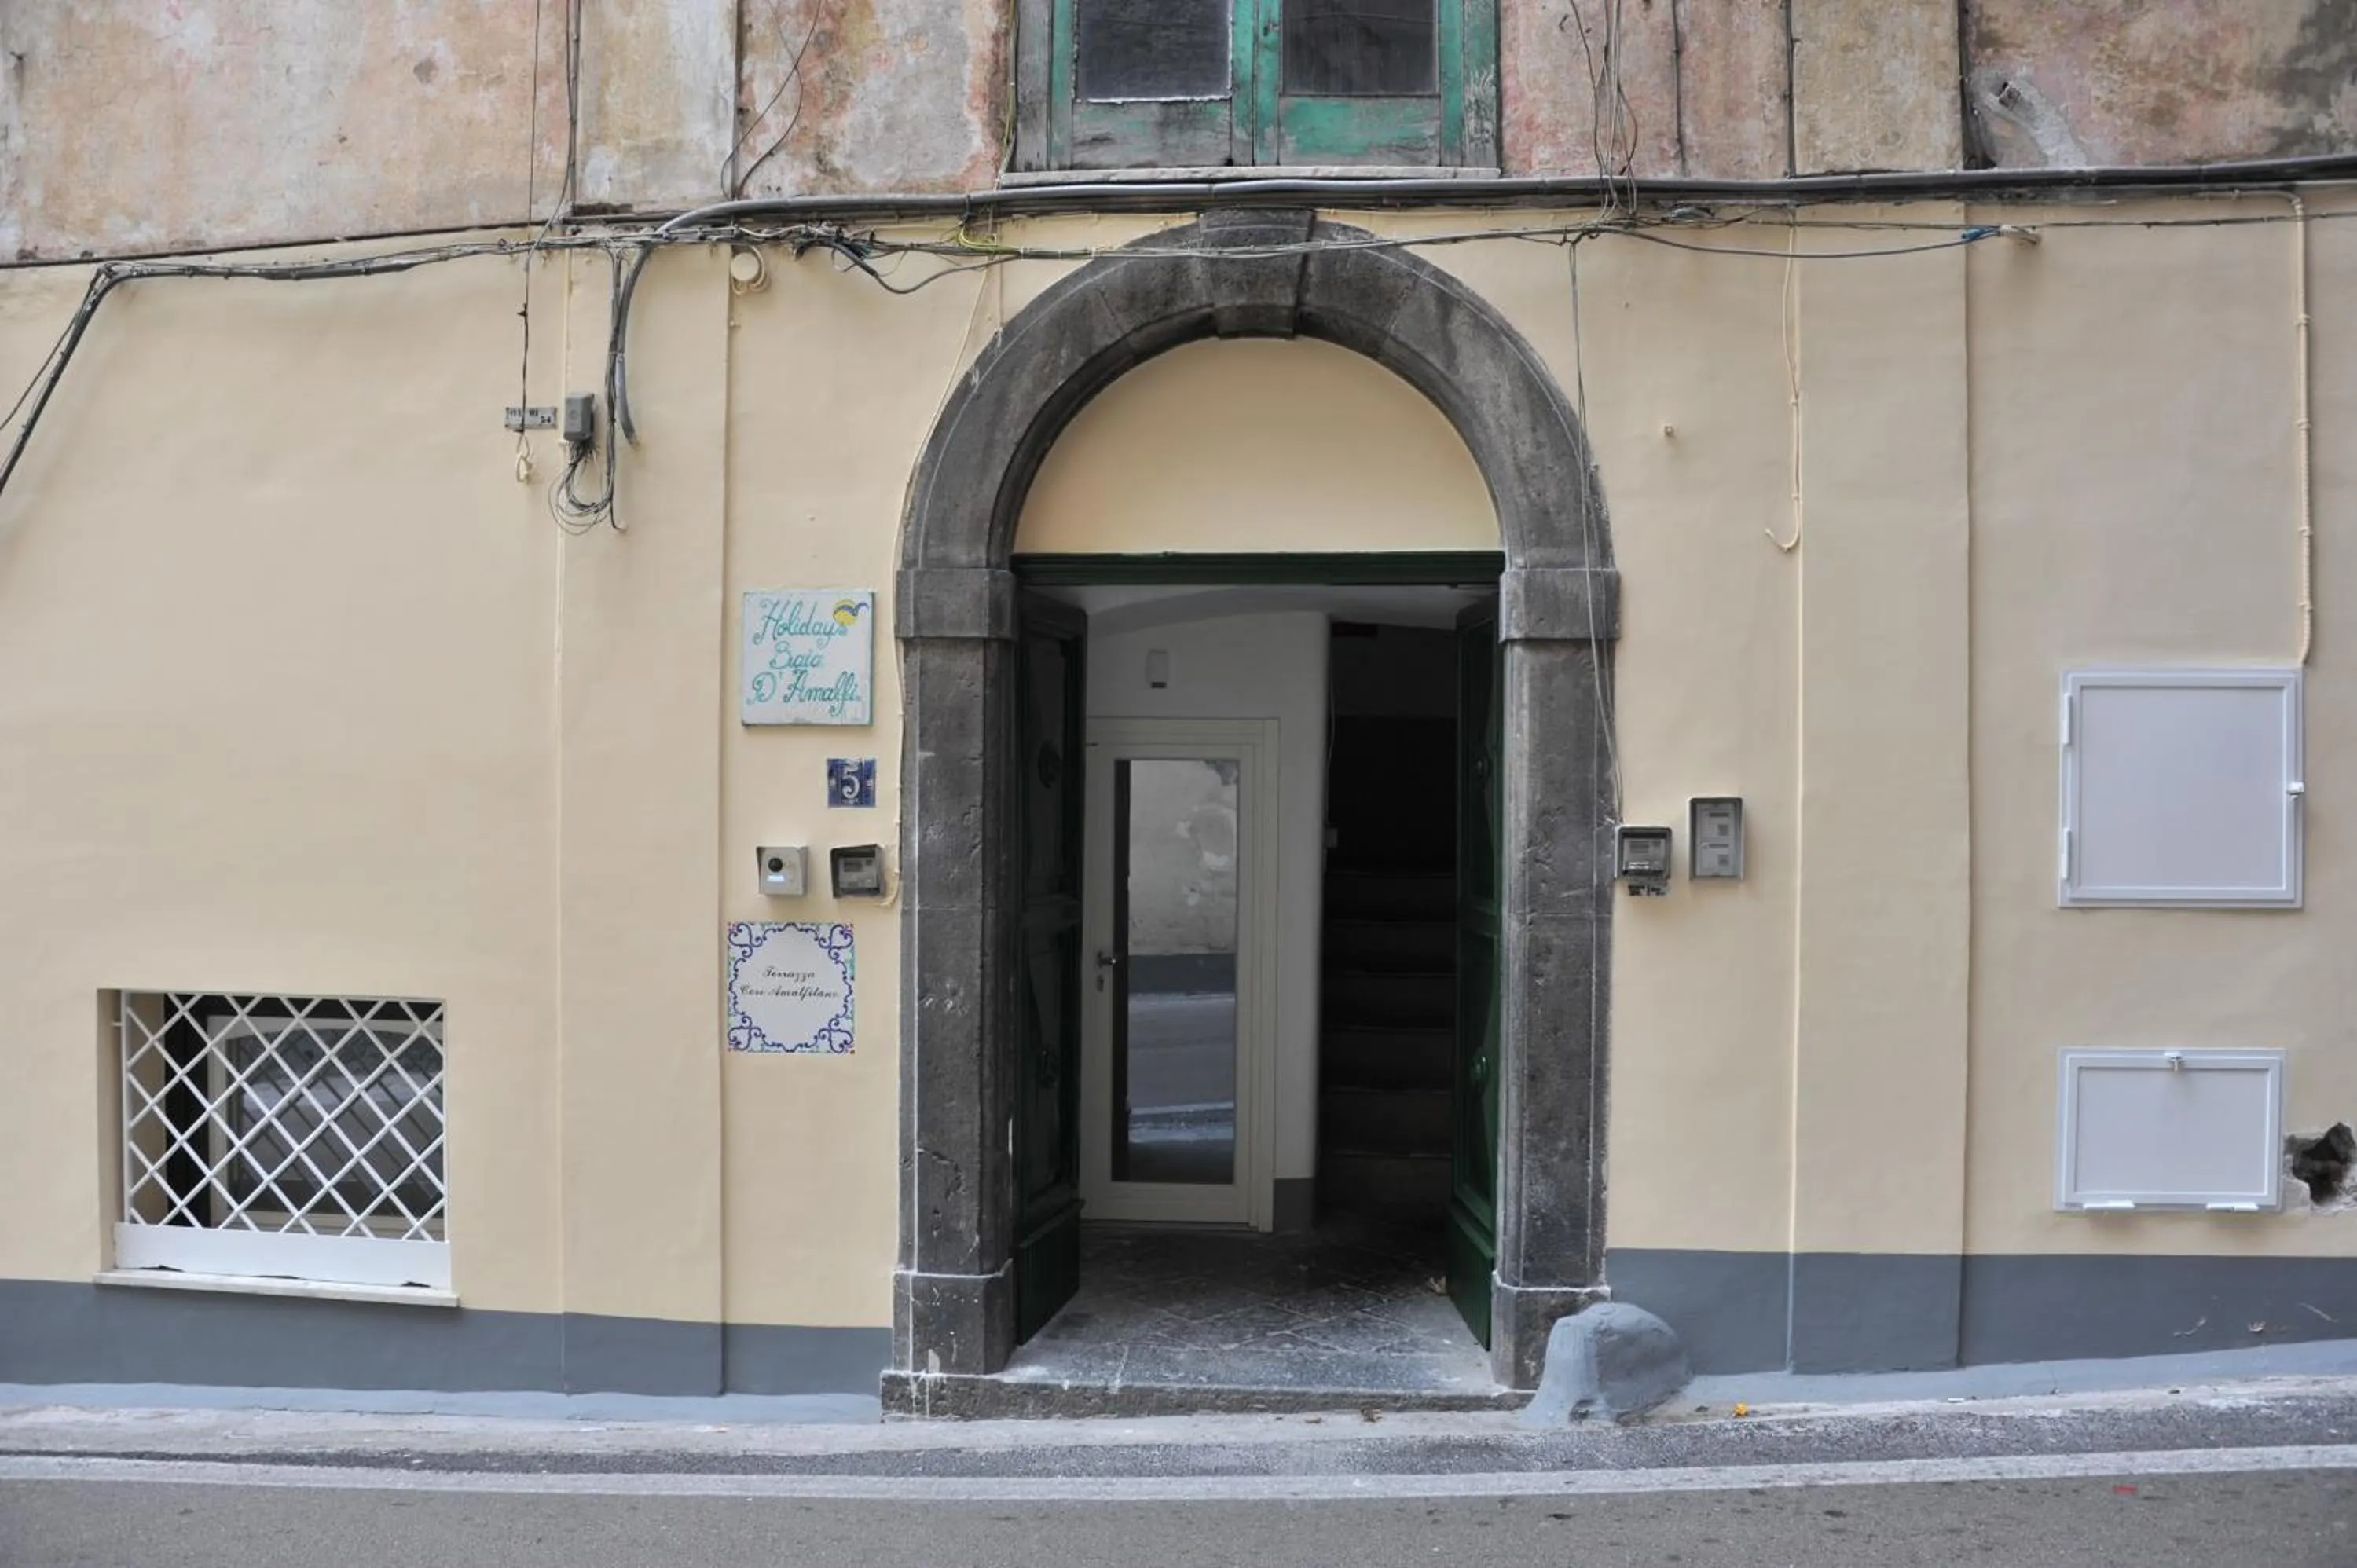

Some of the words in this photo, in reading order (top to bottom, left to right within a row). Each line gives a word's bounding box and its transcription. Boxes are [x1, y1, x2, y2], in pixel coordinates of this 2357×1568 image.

[769, 640, 823, 669] Baia
[746, 669, 862, 716] D'Amalfi
[841, 762, 860, 800] 5
[762, 966, 816, 982] Terrazza
